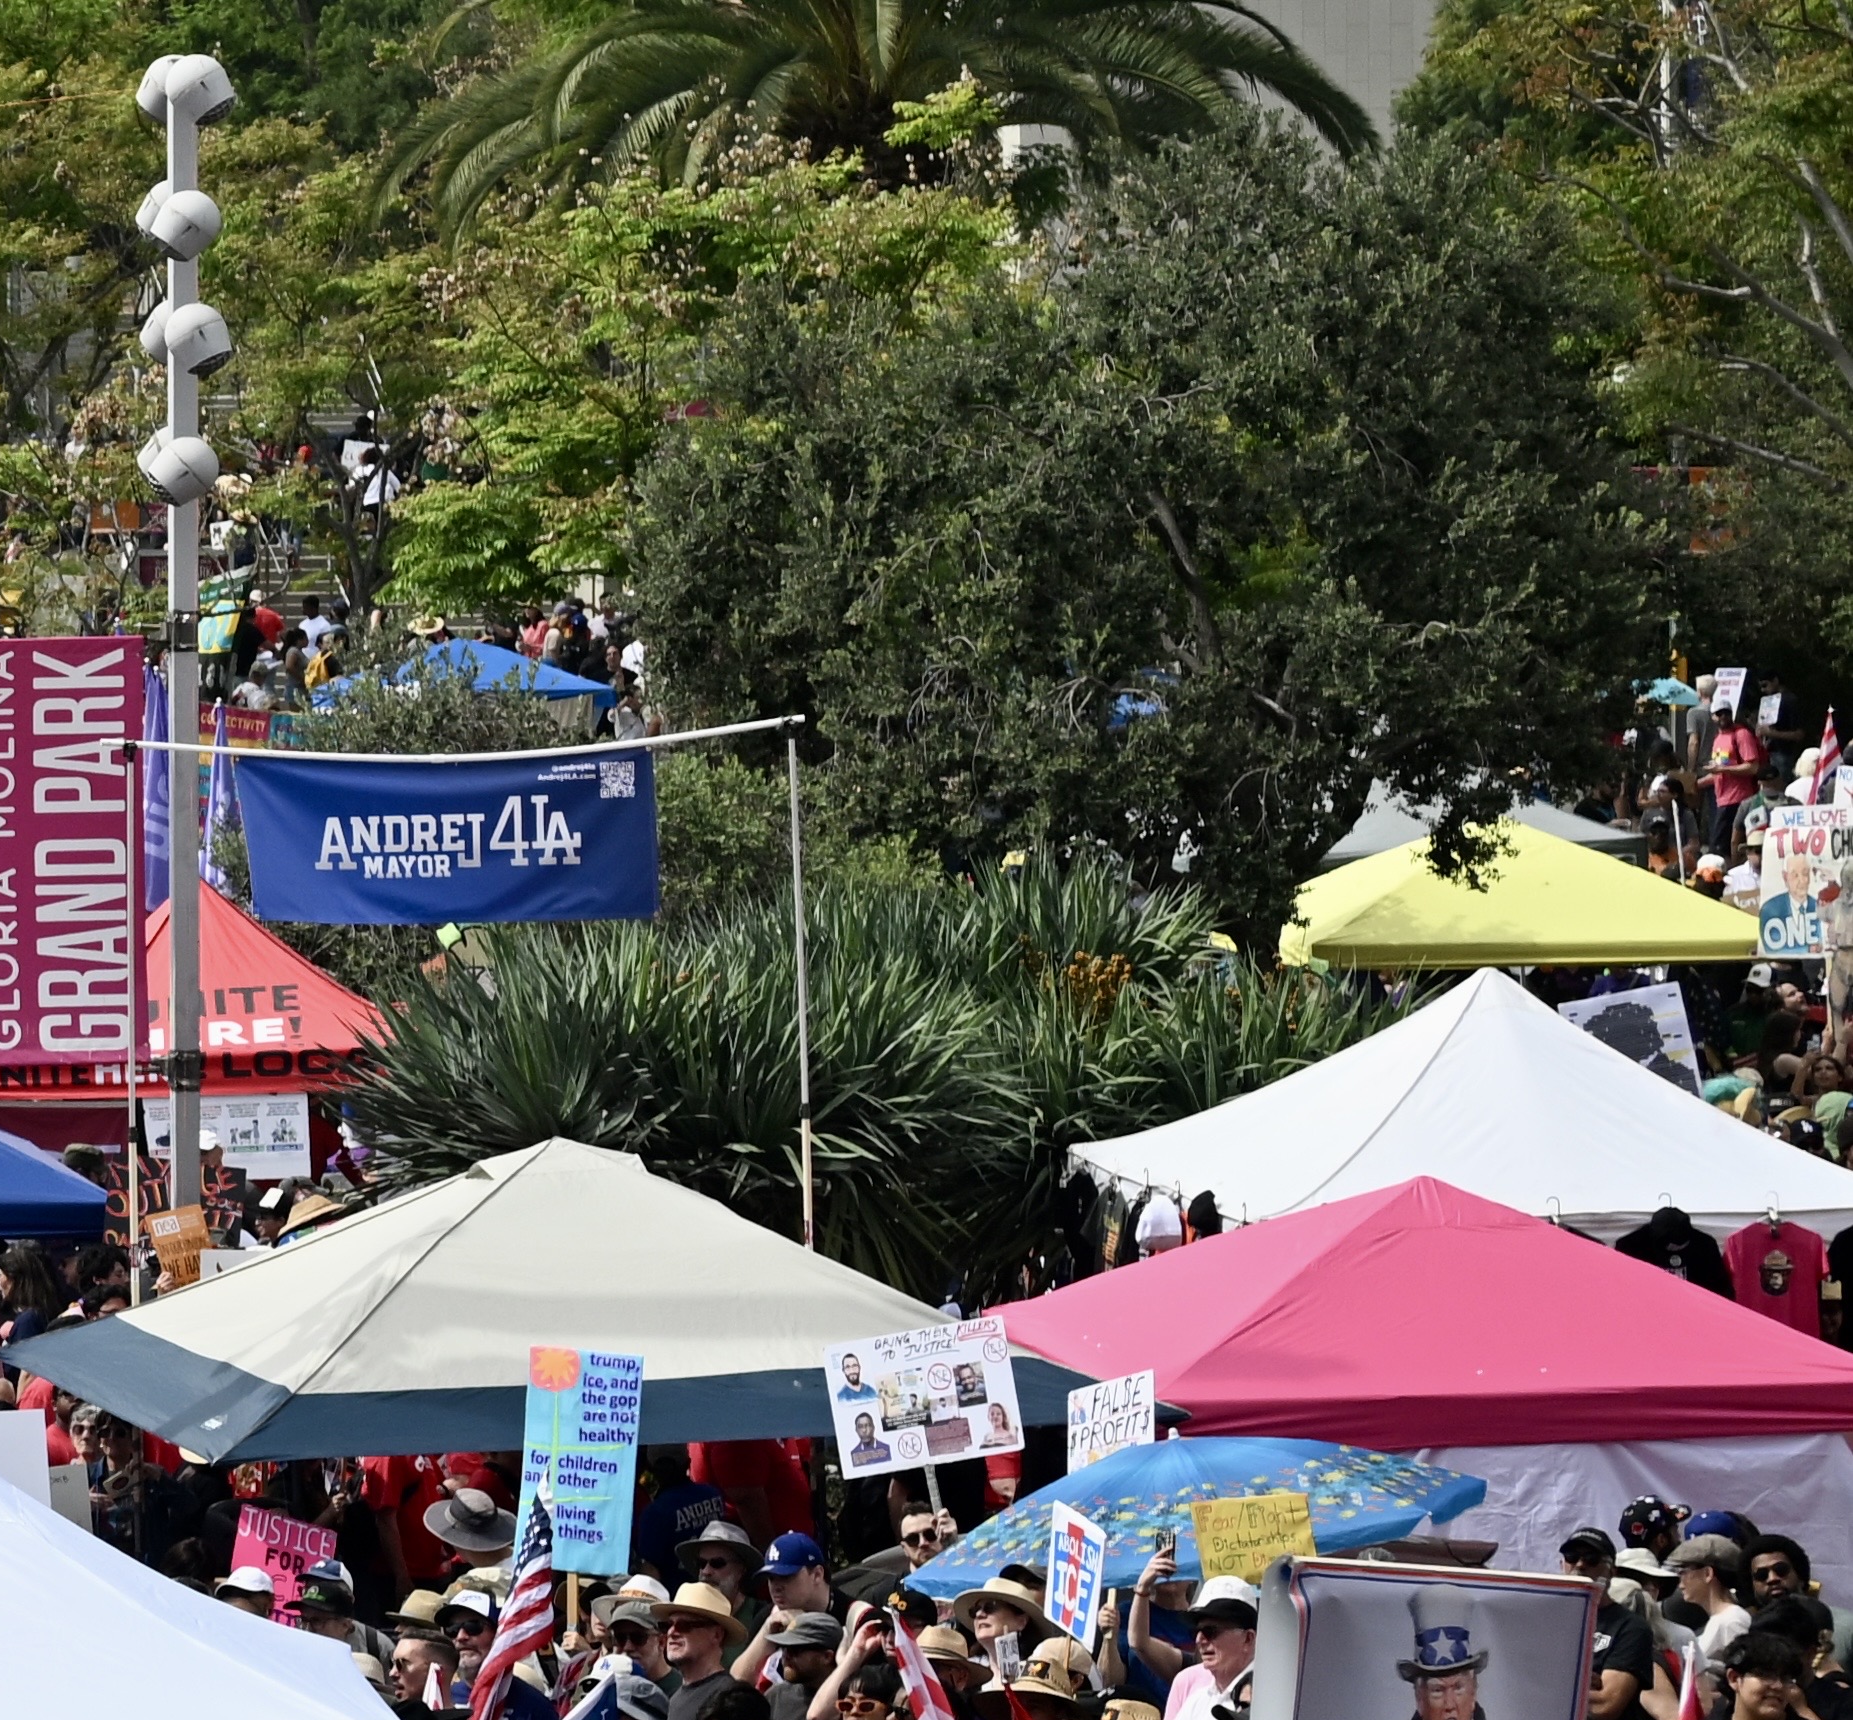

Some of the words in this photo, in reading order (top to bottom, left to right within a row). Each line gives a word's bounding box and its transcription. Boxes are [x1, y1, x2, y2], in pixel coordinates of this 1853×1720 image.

[33, 647, 126, 812] PARK
[315, 812, 485, 871] ANDREJ
[363, 854, 451, 879] MAYOR
[36, 837, 131, 1054] GRAND
[590, 1353, 640, 1373] trump,
[583, 1373, 608, 1391] ice,
[610, 1377, 638, 1391] and
[582, 1391, 606, 1405] the
[610, 1394, 637, 1409] gop
[583, 1412, 607, 1424] are
[610, 1411, 636, 1424] not
[579, 1428, 635, 1445] healthy
[558, 1454, 617, 1474] children
[558, 1474, 598, 1489] other
[556, 1505, 596, 1523] living
[558, 1524, 603, 1544] things
[1058, 1533, 1099, 1572] ABOLISH
[1055, 1562, 1091, 1622] ICE
